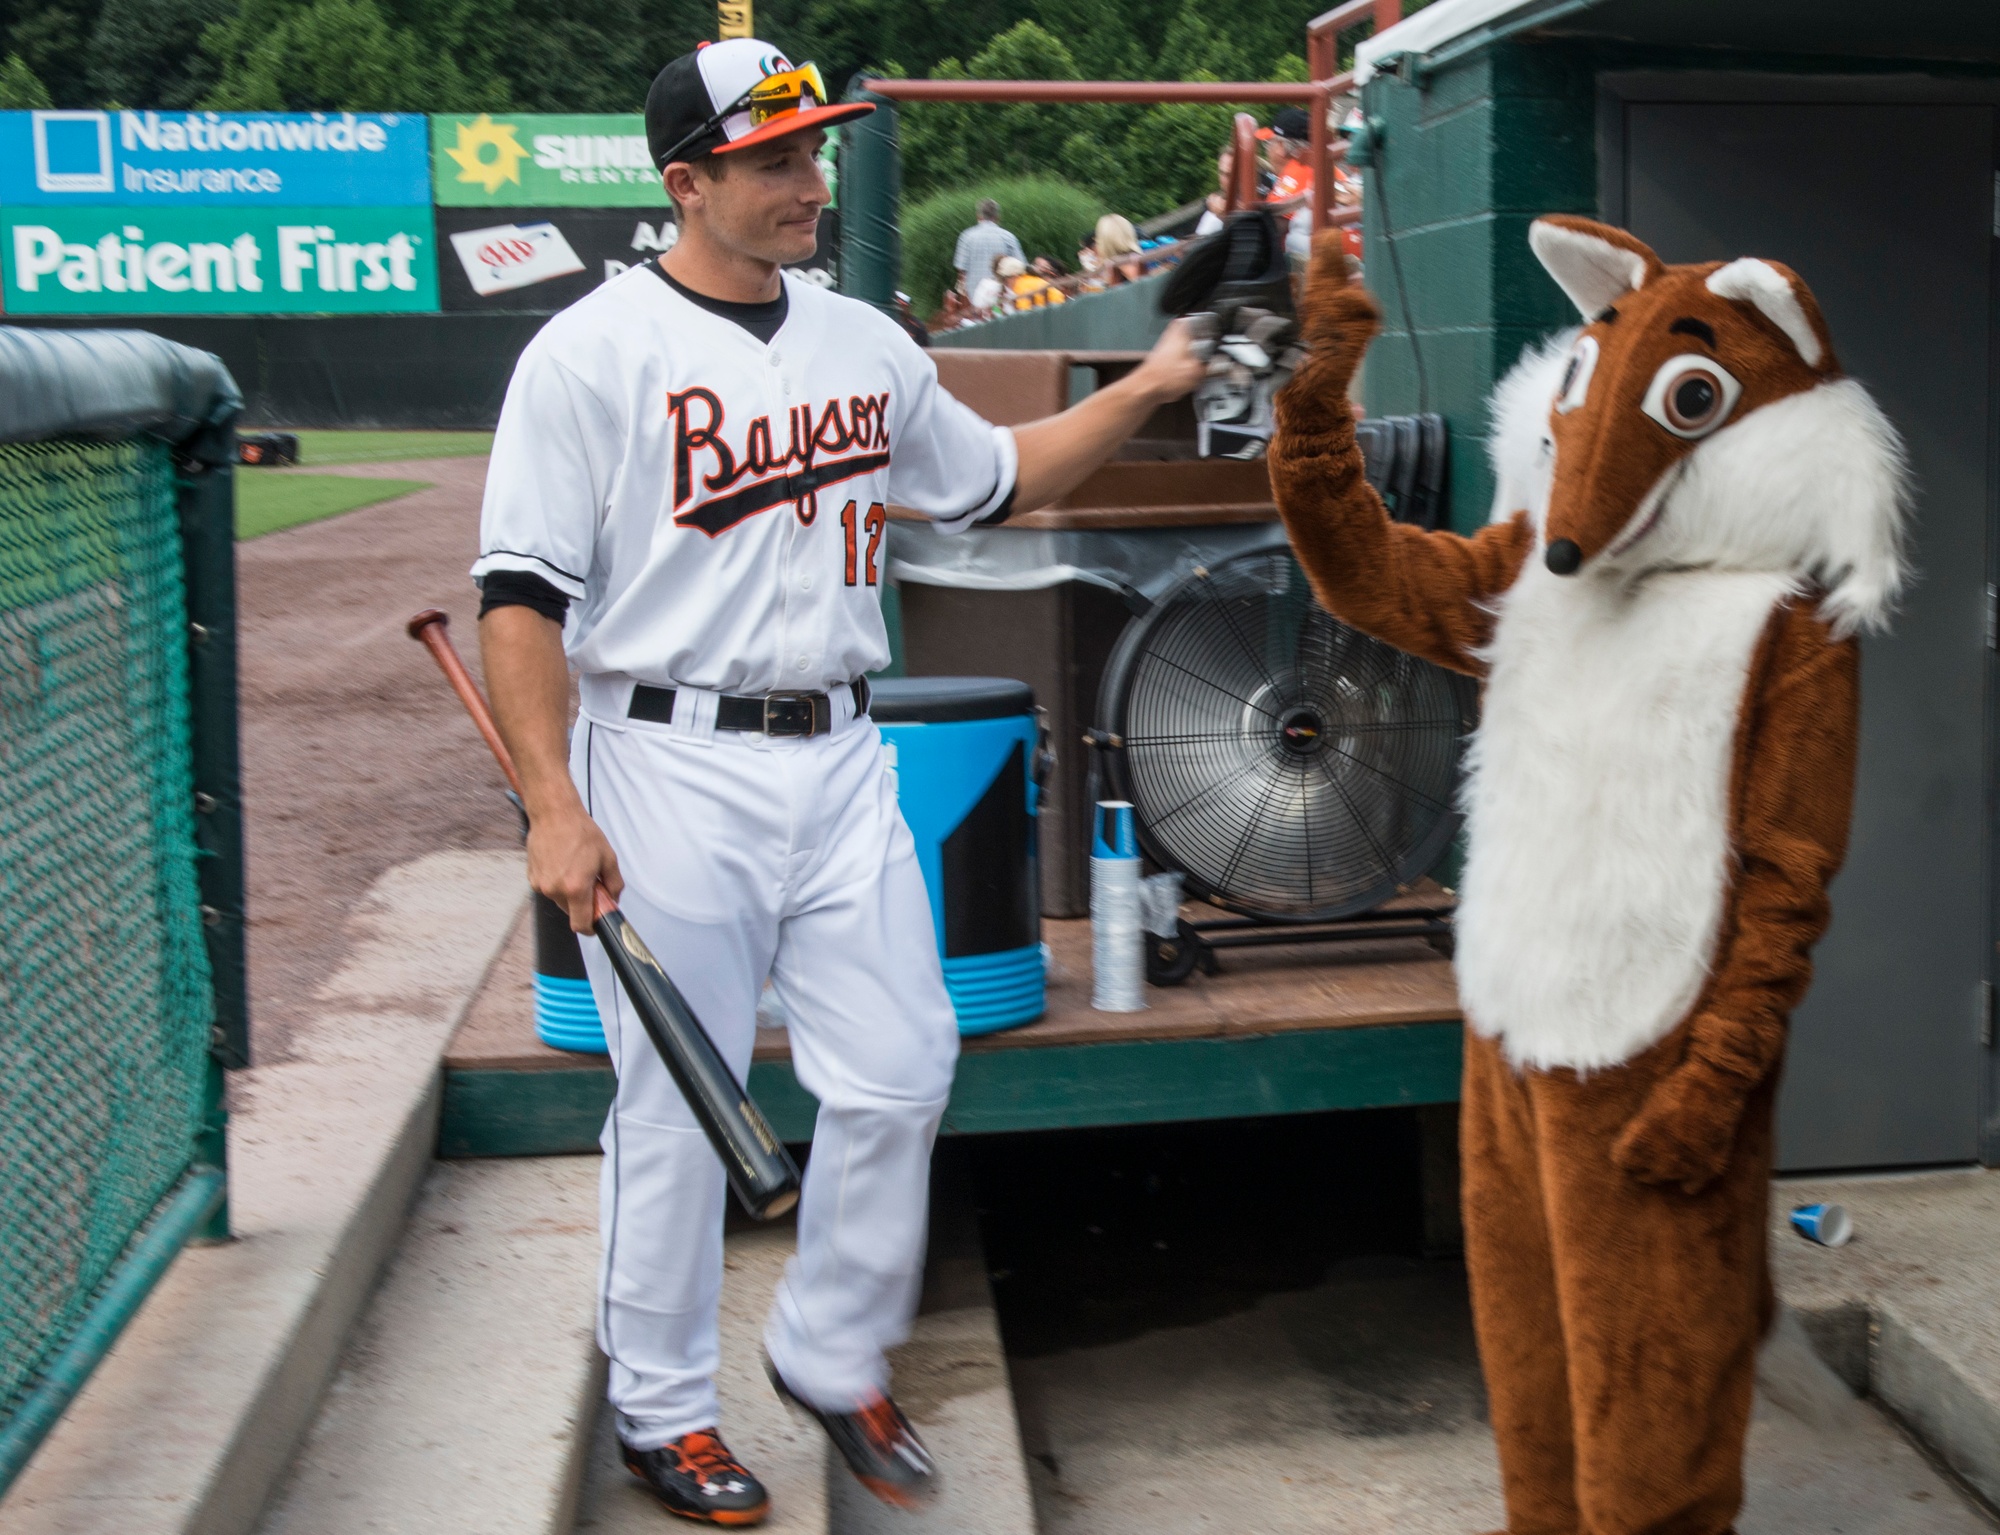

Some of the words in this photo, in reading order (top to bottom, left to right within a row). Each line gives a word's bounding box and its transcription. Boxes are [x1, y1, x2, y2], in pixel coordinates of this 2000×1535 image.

[119, 110, 388, 152] Nationwide
[122, 162, 282, 193] Insurance
[12, 224, 264, 293] Patient
[276, 224, 419, 292] First
[666, 386, 890, 527] Baysox
[840, 499, 887, 587] 12
